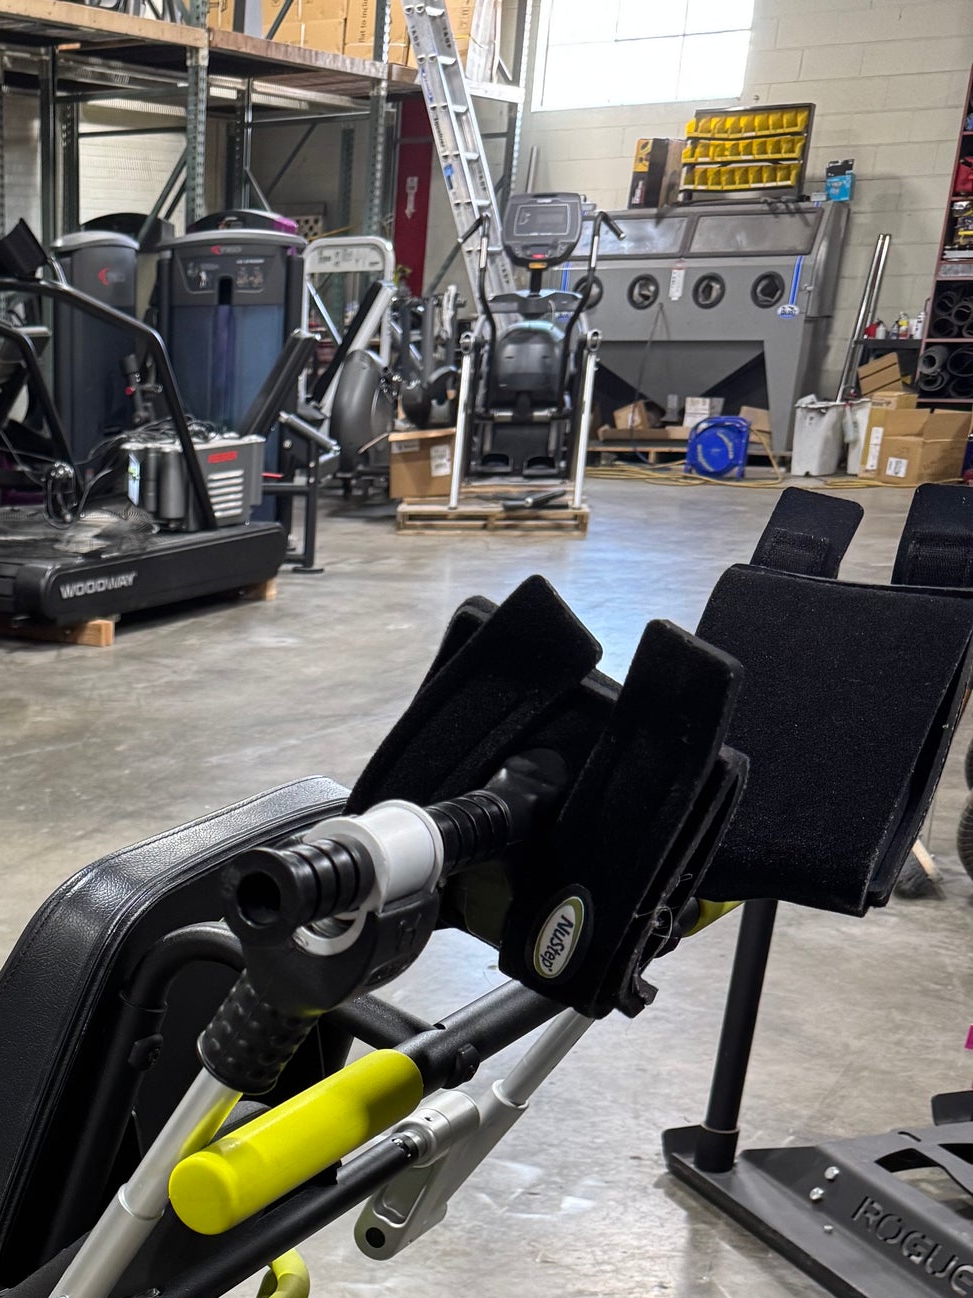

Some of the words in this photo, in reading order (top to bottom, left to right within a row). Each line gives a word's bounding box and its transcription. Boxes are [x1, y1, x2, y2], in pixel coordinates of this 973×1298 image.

[59, 570, 138, 599] WOODWAY
[540, 914, 574, 970] NuStep
[851, 1196, 973, 1297] ROGUE
